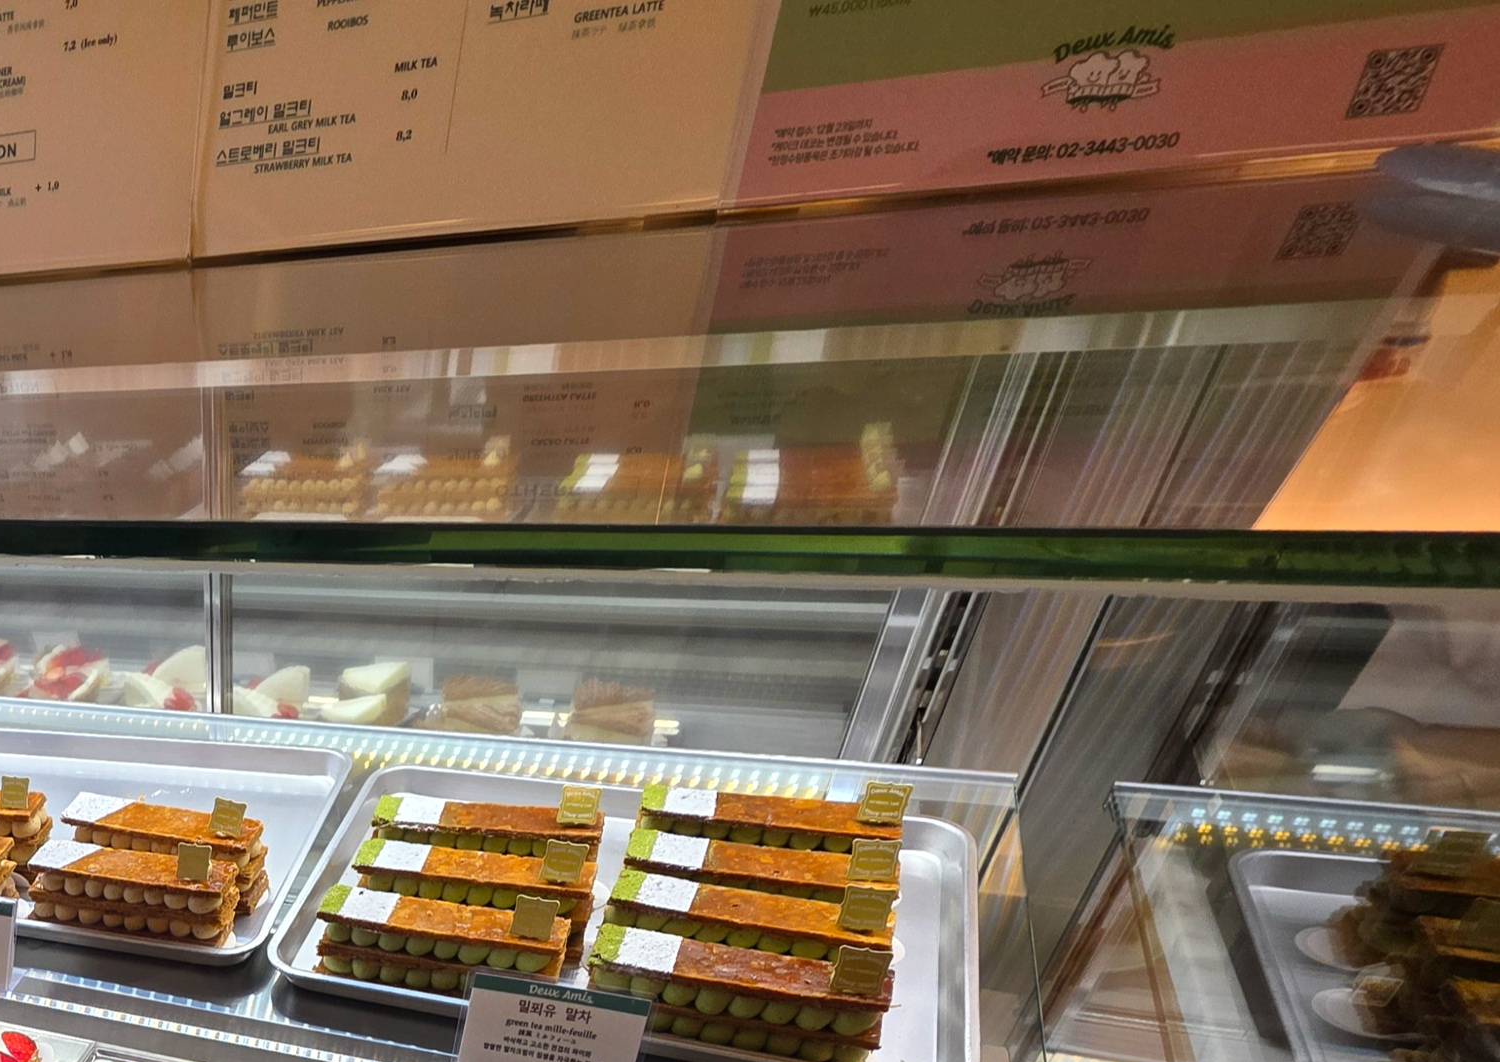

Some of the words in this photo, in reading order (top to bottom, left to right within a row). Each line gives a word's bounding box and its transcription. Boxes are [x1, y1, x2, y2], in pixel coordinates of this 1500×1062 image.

[228, 1, 278, 23] 페퍼민트
[574, 6, 628, 23] GREENTEA
[632, 0, 664, 14] LATTE
[64, 40, 76, 52] 7,2
[80, 37, 96, 50] (Ice
[97, 33, 118, 47] only)
[226, 28, 276, 50] 루이보스
[327, 15, 368, 31] ROOIBOS
[1053, 31, 1115, 64] Deux
[1118, 24, 1175, 50] Amis
[394, 60, 417, 73] MILK
[420, 57, 438, 69] TEA
[223, 80, 258, 100] 밀크티
[401, 88, 418, 102] 8,0
[219, 105, 268, 127] 얼그레이
[273, 99, 311, 119] 밀크티
[268, 122, 289, 135] EARL
[291, 119, 313, 132] GREY
[315, 117, 338, 129] MILK
[340, 113, 356, 125] TEA
[216, 142, 277, 164] 스트로베리
[282, 136, 320, 156] 밀크티
[396, 129, 413, 142] 8,2
[1021, 144, 1052, 163] 문의:
[1056, 131, 1180, 159] 02-3443-0030
[254, 159, 310, 174] STRAWBERRY
[312, 155, 334, 168] MILK
[336, 153, 352, 164] TEA
[47, 180, 60, 192] 1,0
[529, 984, 559, 997] Deux
[562, 990, 594, 1004] Amis
[518, 999, 557, 1018] 밀푀유
[565, 1006, 592, 1024] 말차
[505, 1018, 529, 1028] green
[531, 1022, 543, 1030] tea
[545, 1024, 597, 1041] mille-feuille
